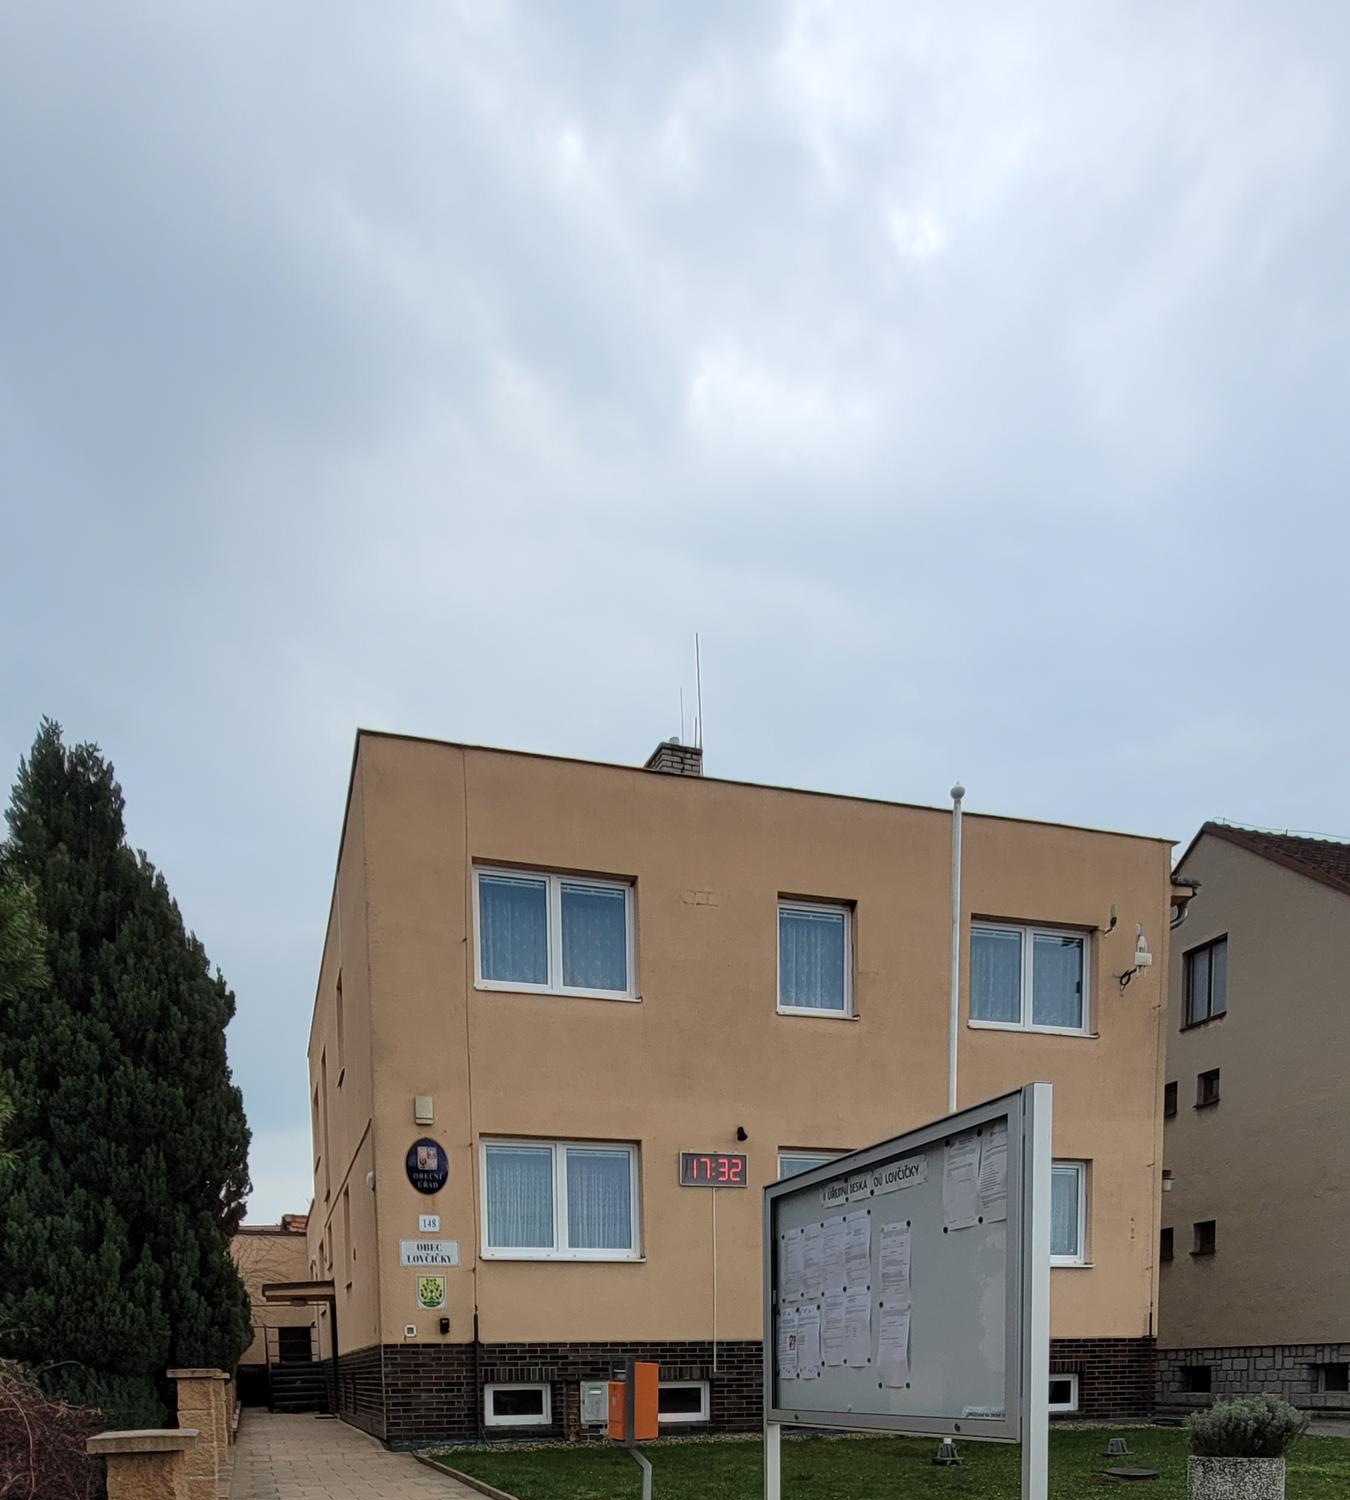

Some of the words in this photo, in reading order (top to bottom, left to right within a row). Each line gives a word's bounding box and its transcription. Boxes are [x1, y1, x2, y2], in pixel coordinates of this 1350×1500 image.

[693, 1158, 742, 1181] 17:32
[885, 1164, 919, 1185] LOVČIČKY
[422, 1218, 437, 1229] 148
[416, 1243, 442, 1252] OBEC
[407, 1253, 452, 1264] LOVČIČKY
